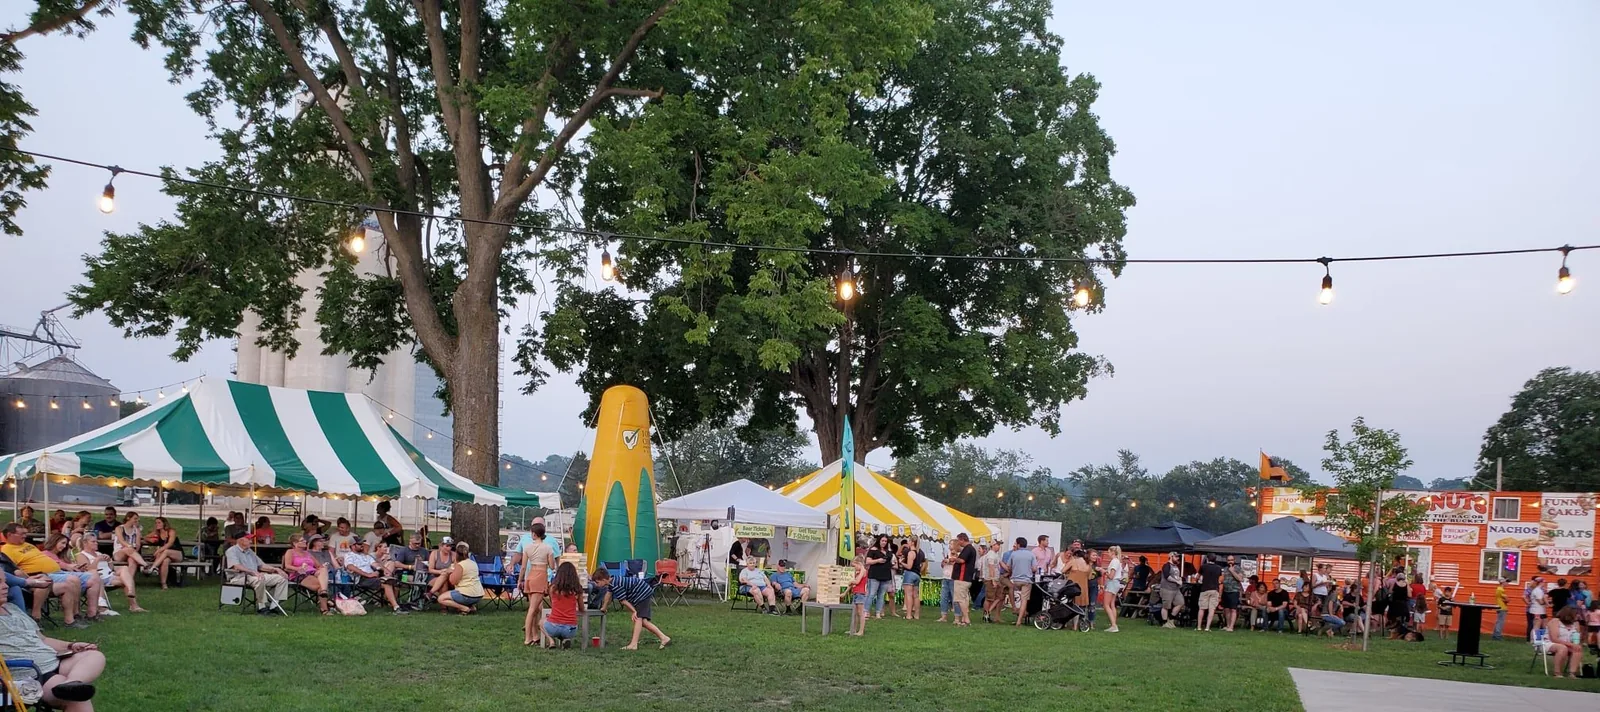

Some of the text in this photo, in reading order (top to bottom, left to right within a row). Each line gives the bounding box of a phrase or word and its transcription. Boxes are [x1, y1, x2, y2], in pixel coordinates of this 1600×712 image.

[1548, 508, 1588, 516] CAKES
[1489, 525, 1538, 534] NACHOS
[1547, 529, 1593, 538] BRATS
[1542, 548, 1589, 557] WALKING
[1549, 557, 1581, 565] TACOS
